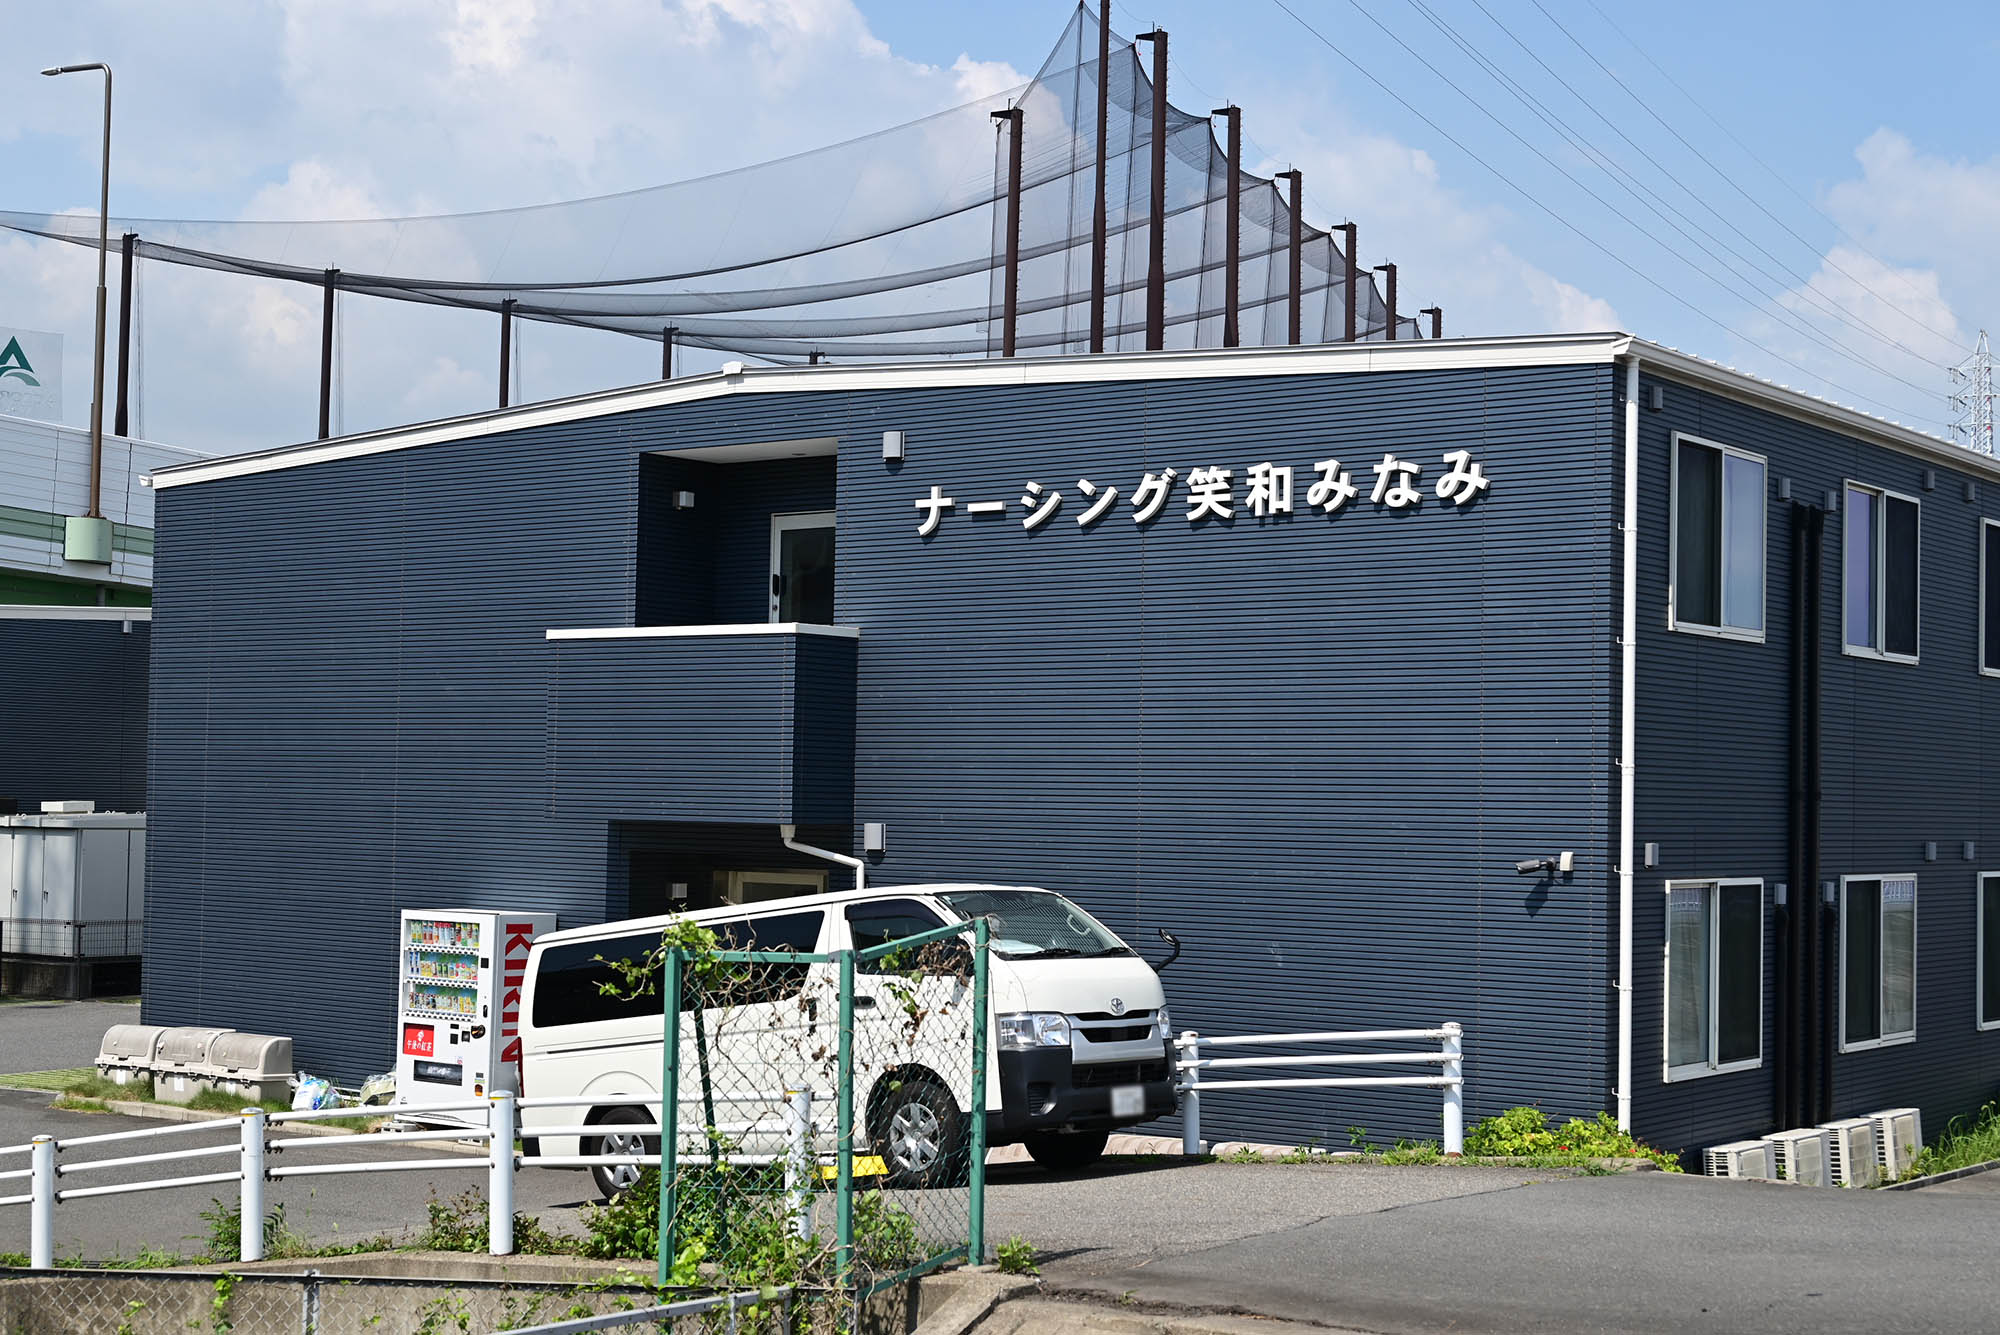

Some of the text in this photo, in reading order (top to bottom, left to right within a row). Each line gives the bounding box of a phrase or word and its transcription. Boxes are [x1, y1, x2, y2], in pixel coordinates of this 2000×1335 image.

[915, 450, 1491, 537] ナーシング笑和みなみ
